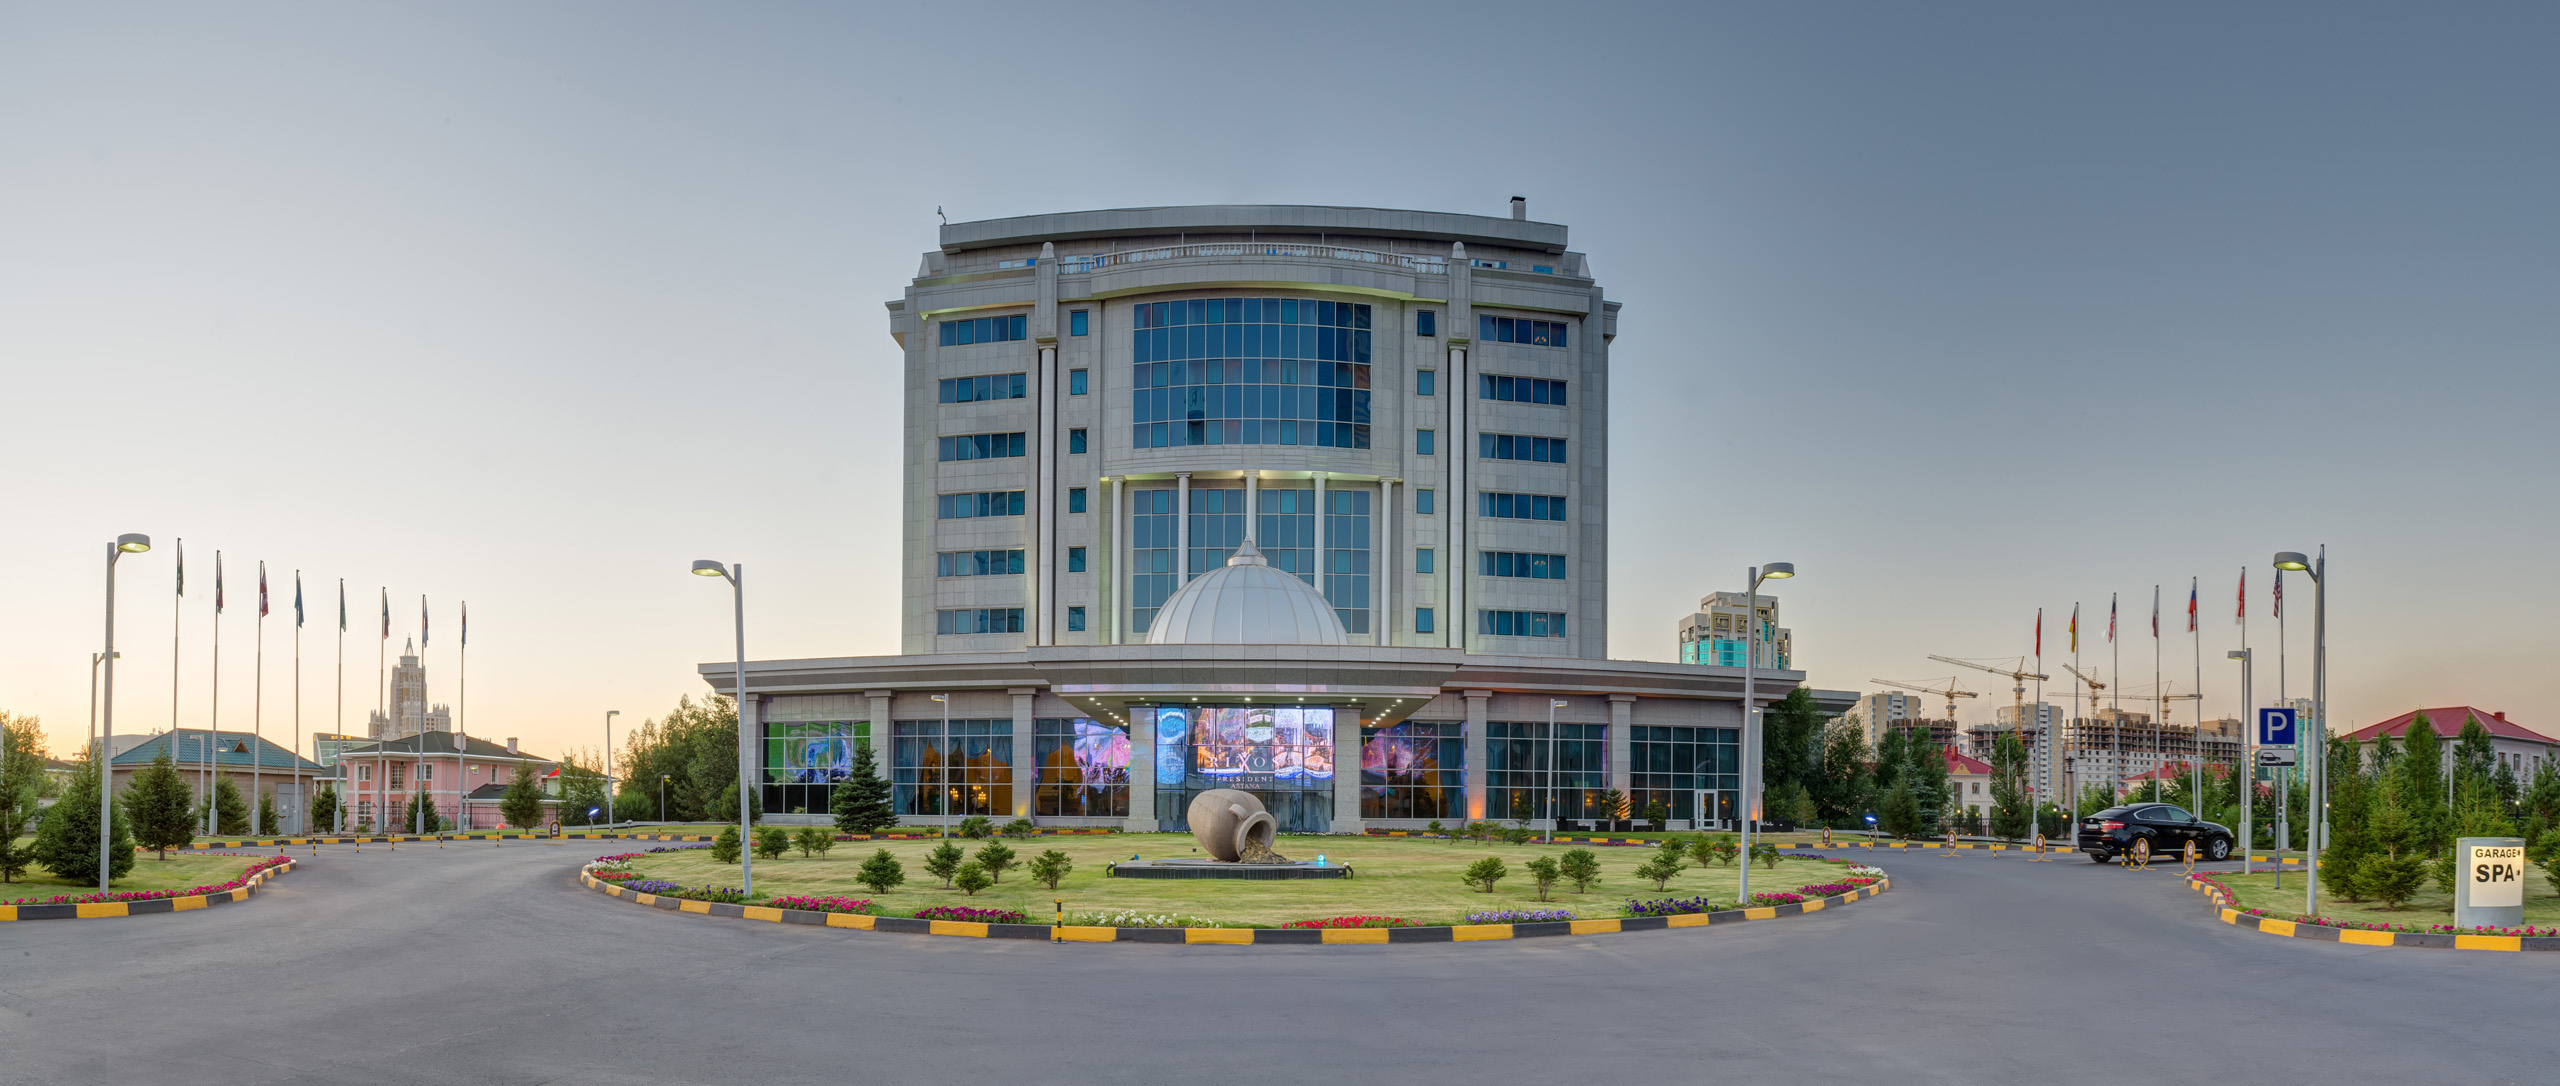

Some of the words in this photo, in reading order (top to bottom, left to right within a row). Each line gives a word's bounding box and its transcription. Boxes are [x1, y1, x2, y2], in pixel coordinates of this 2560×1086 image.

[2267, 711, 2288, 741] P
[1209, 753, 1279, 773] RIXOS
[2475, 848, 2517, 858] GARAGE
[2475, 863, 2515, 883] SPA
